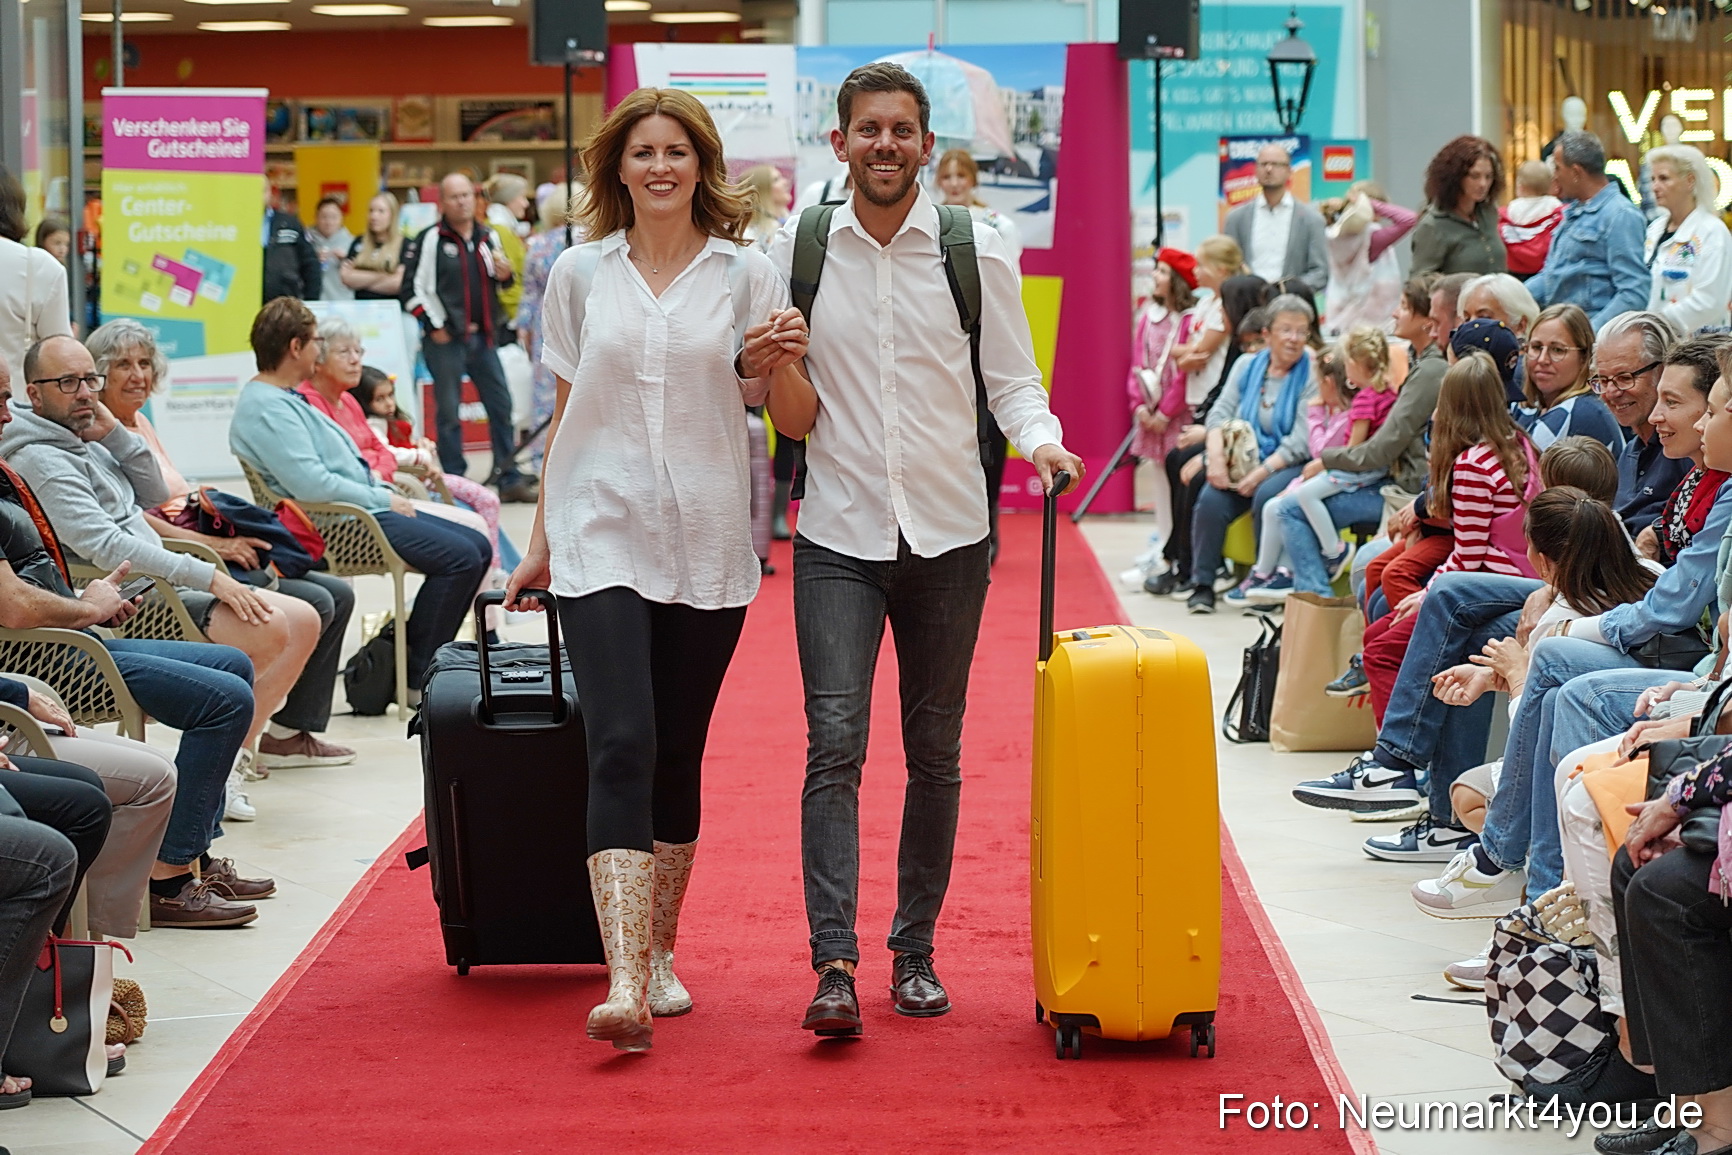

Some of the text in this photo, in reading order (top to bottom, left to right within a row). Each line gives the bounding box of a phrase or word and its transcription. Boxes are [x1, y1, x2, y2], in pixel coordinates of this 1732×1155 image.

[1608, 88, 1732, 143] VE
[112, 117, 250, 137] Verschenken Sie
[148, 138, 250, 158] Gutscheine!
[121, 196, 192, 216] Center-
[128, 221, 237, 242] Gutscheine
